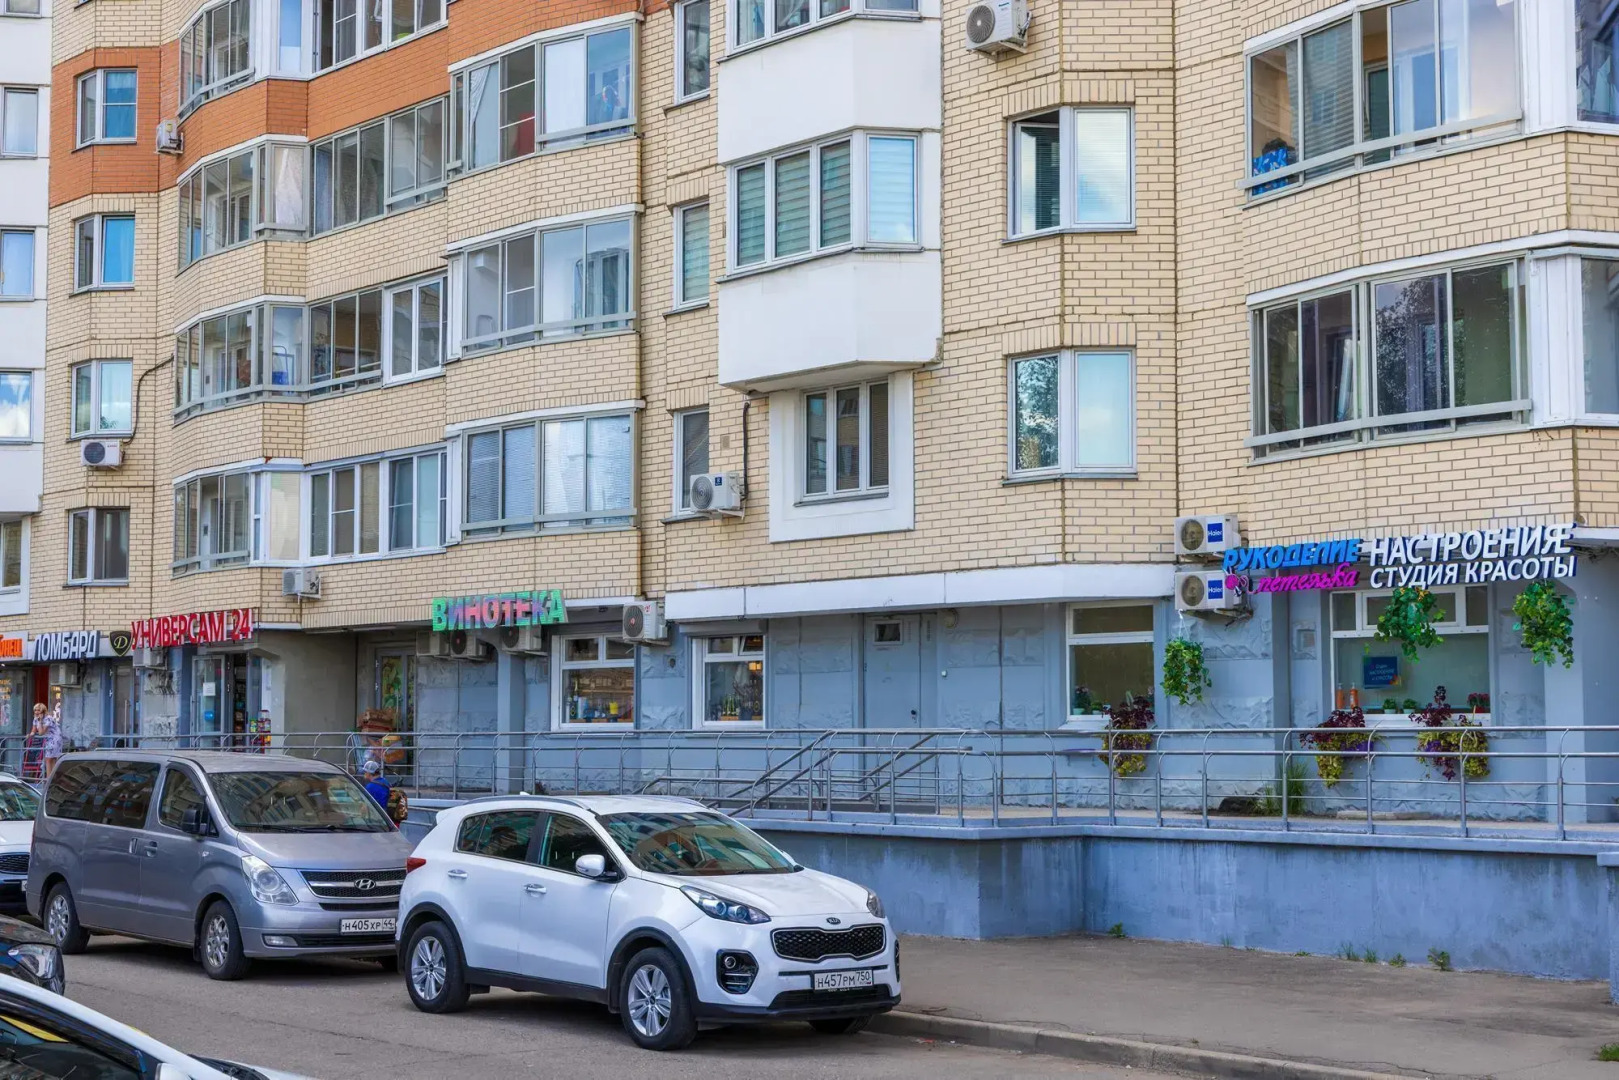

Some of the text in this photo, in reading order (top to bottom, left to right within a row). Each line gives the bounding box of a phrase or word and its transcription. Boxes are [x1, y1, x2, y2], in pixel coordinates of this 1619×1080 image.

[1223, 538, 1363, 571] РУКОДЕЛИЕ
[1370, 555, 1577, 590] СТУДИЯ КРАСОТЫ
[432, 589, 568, 631] ВИНОТЕКА
[32, 630, 98, 661] ЛОМБАРД
[131, 608, 253, 650] УНИВЕРСАМ 24
